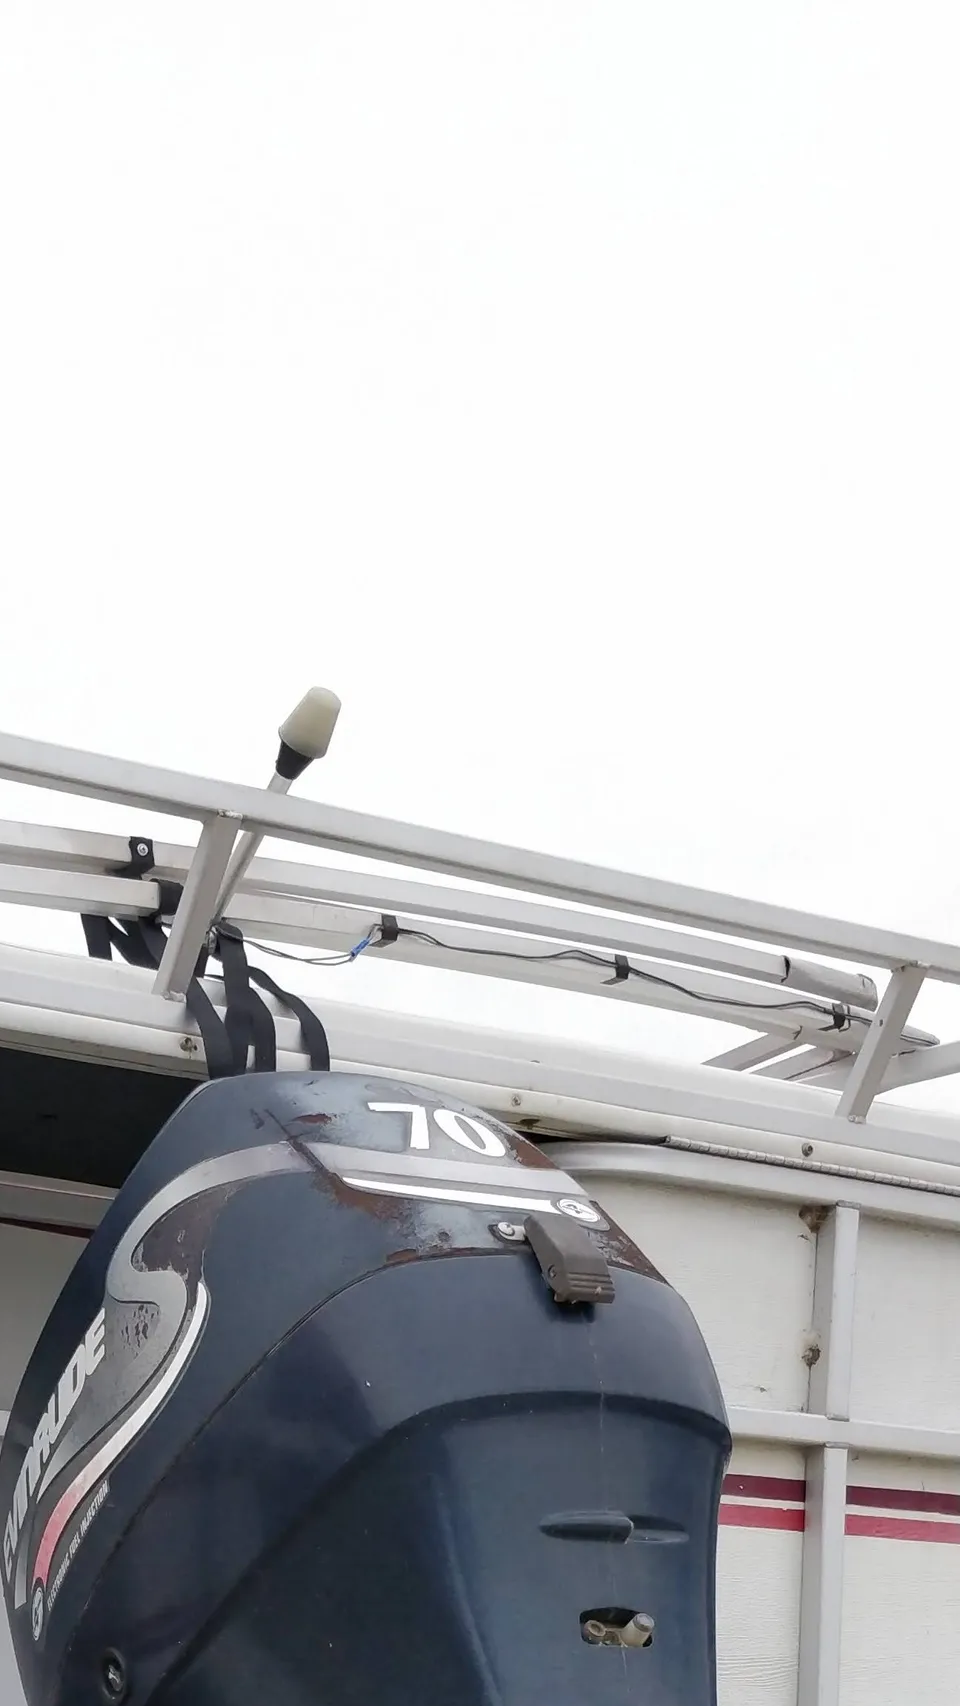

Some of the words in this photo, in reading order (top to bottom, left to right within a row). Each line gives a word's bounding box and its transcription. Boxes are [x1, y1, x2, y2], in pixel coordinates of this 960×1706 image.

[368, 1102, 506, 1157] 70
[3, 1307, 106, 1580] EVINRUDE
[47, 1551, 70, 1612] ELECTRONIC
[68, 1533, 81, 1558] FUEL
[80, 1480, 109, 1537] INJECTION
